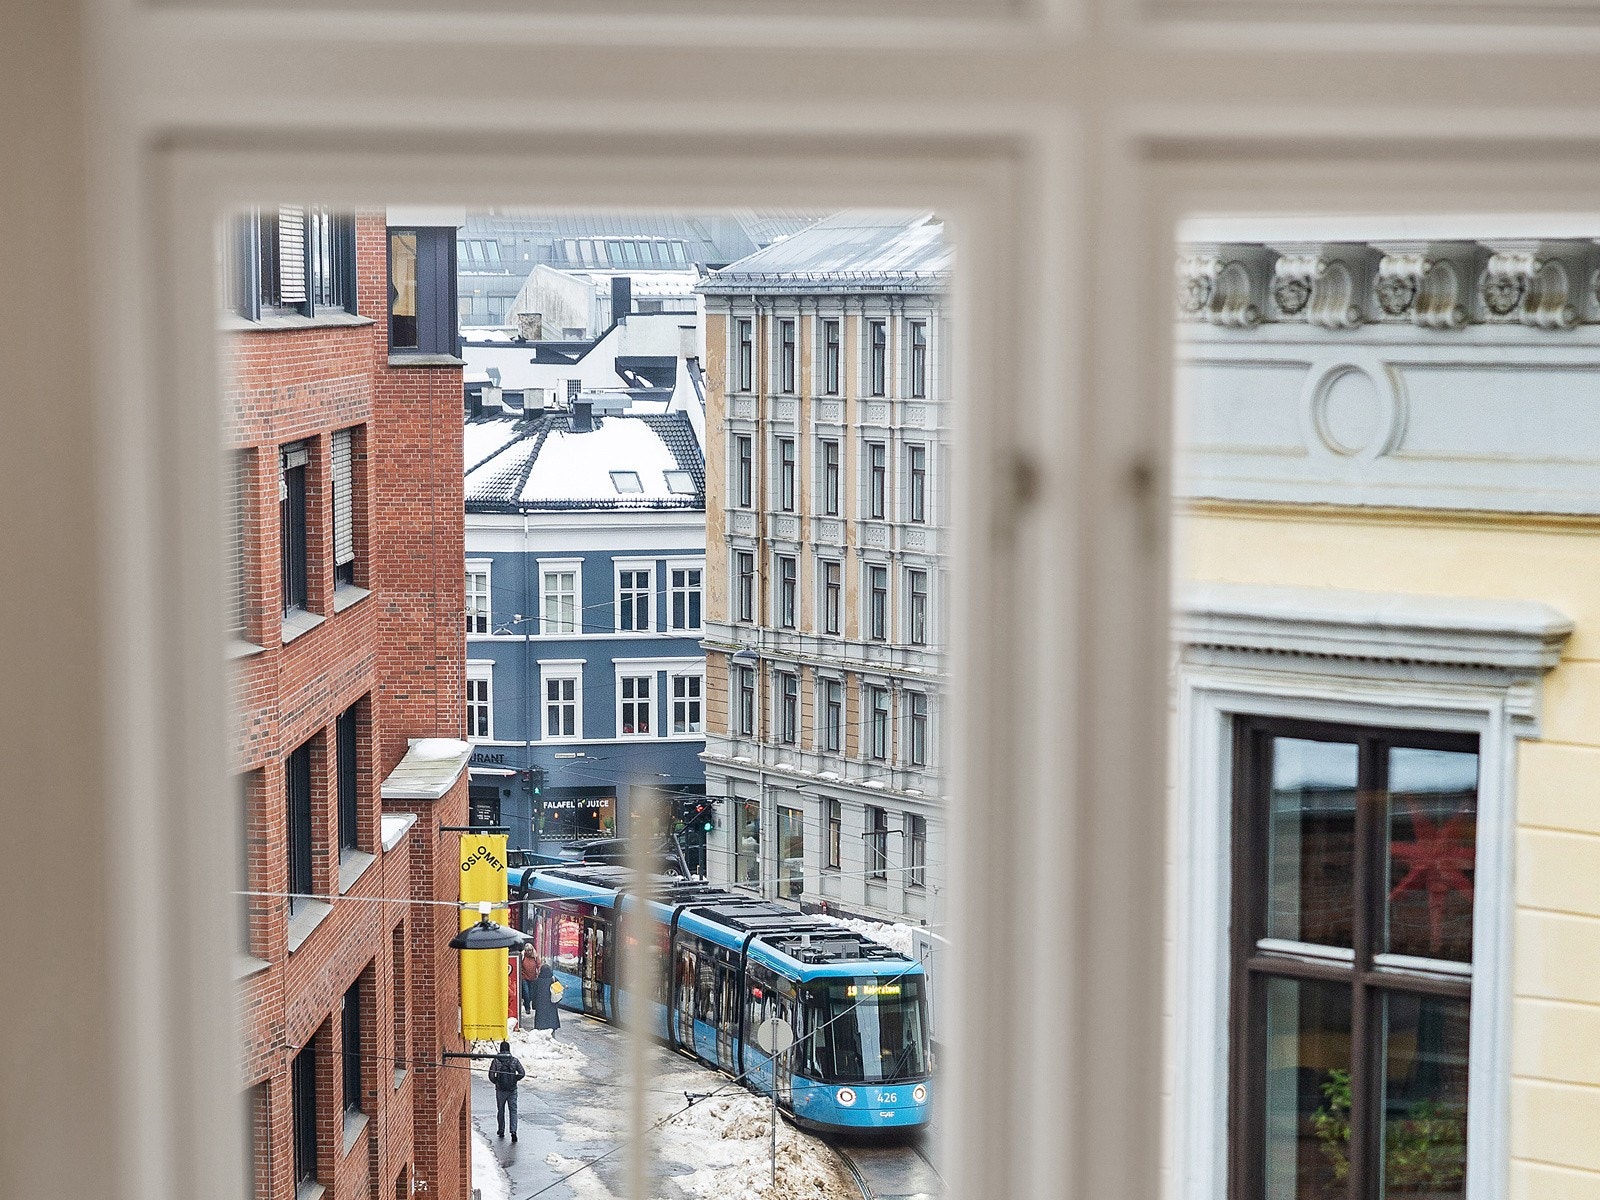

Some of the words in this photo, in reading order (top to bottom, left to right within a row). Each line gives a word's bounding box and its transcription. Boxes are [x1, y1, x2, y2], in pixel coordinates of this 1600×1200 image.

[543, 801, 575, 809] FALAFEL
[586, 800, 609, 808] JUICE
[461, 846, 504, 872] OSLOMET
[877, 1092, 897, 1103] 426
